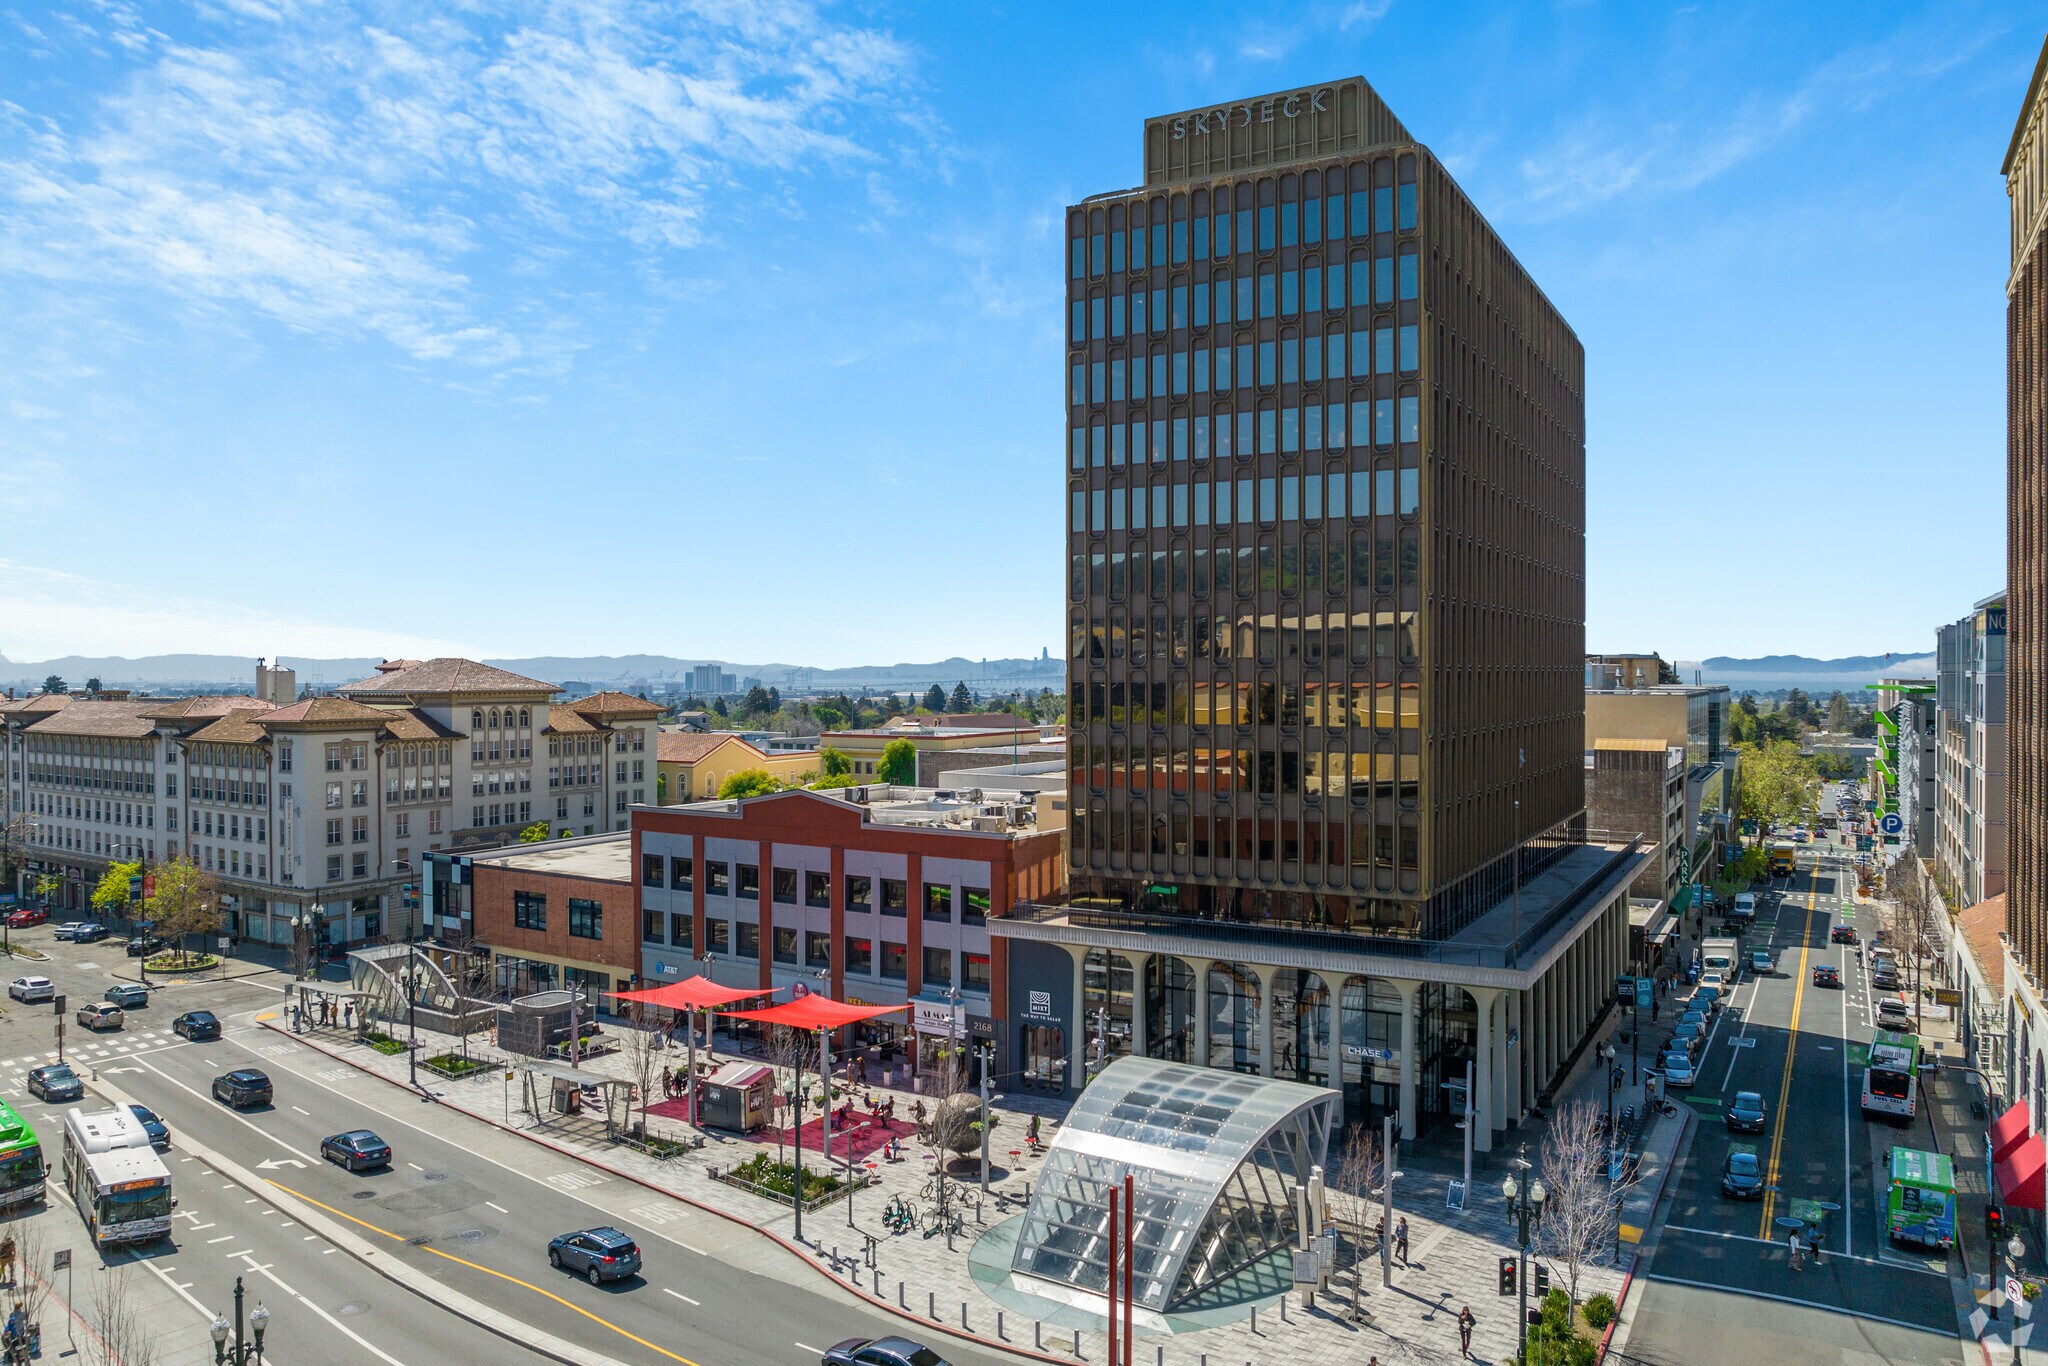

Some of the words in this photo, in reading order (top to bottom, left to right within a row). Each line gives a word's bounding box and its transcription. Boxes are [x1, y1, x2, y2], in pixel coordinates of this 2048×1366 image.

[1172, 90, 1327, 140] SKYDECK
[1886, 817, 1898, 830] P
[1681, 851, 1689, 884] PARK
[664, 965, 678, 975] AT&T
[973, 1021, 993, 1032] 2168
[1348, 1046, 1381, 1058] CHASE
